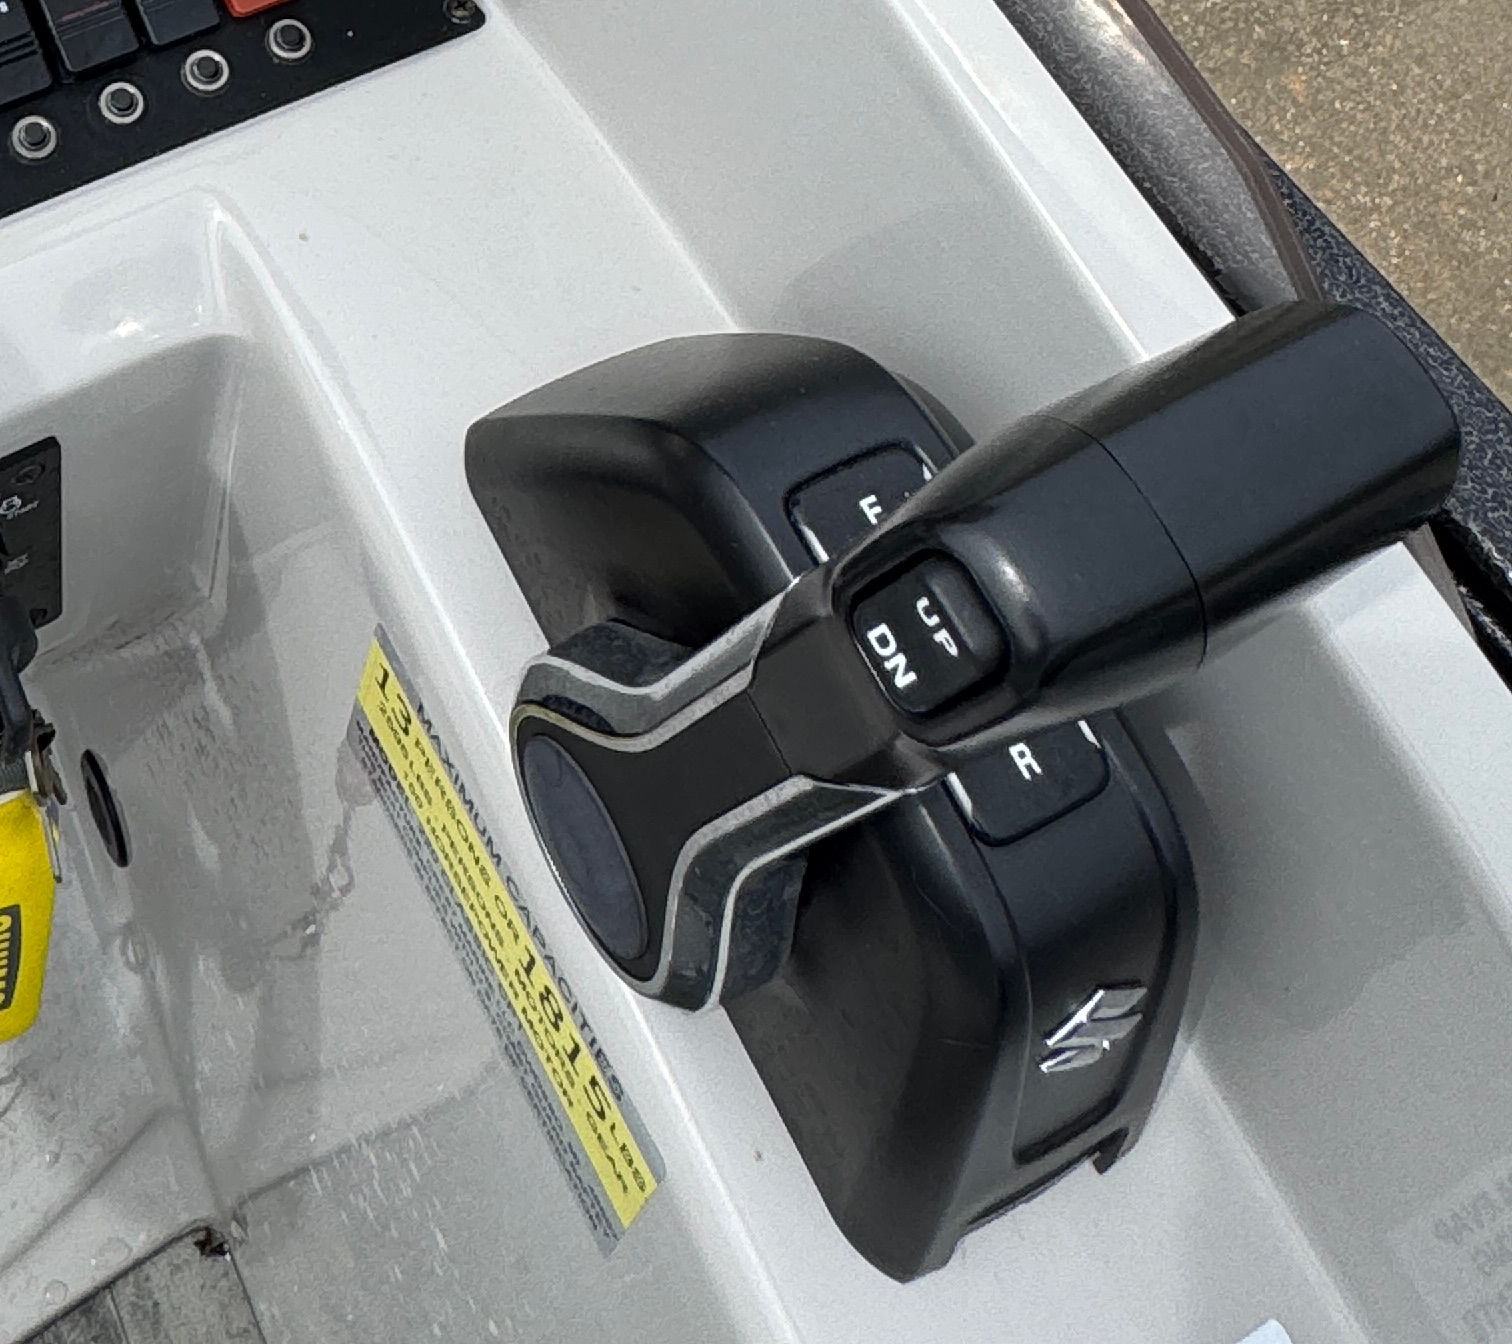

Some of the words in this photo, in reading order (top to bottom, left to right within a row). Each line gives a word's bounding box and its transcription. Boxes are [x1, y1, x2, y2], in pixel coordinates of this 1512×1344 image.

[859, 494, 883, 526] F
[866, 622, 918, 690] DN
[915, 596, 960, 658] UP
[1008, 741, 1044, 782] R
[374, 657, 413, 741] 13
[414, 735, 491, 889] PERSONS
[492, 890, 520, 945] OR
[517, 941, 612, 1125] 1815
[608, 1120, 648, 1195] LBS
[416, 700, 502, 868] MAXIMUM
[504, 869, 626, 1106] CAPACITIES
[520, 1004, 574, 1110] MOTOR
[585, 1109, 629, 1194] GEAR
